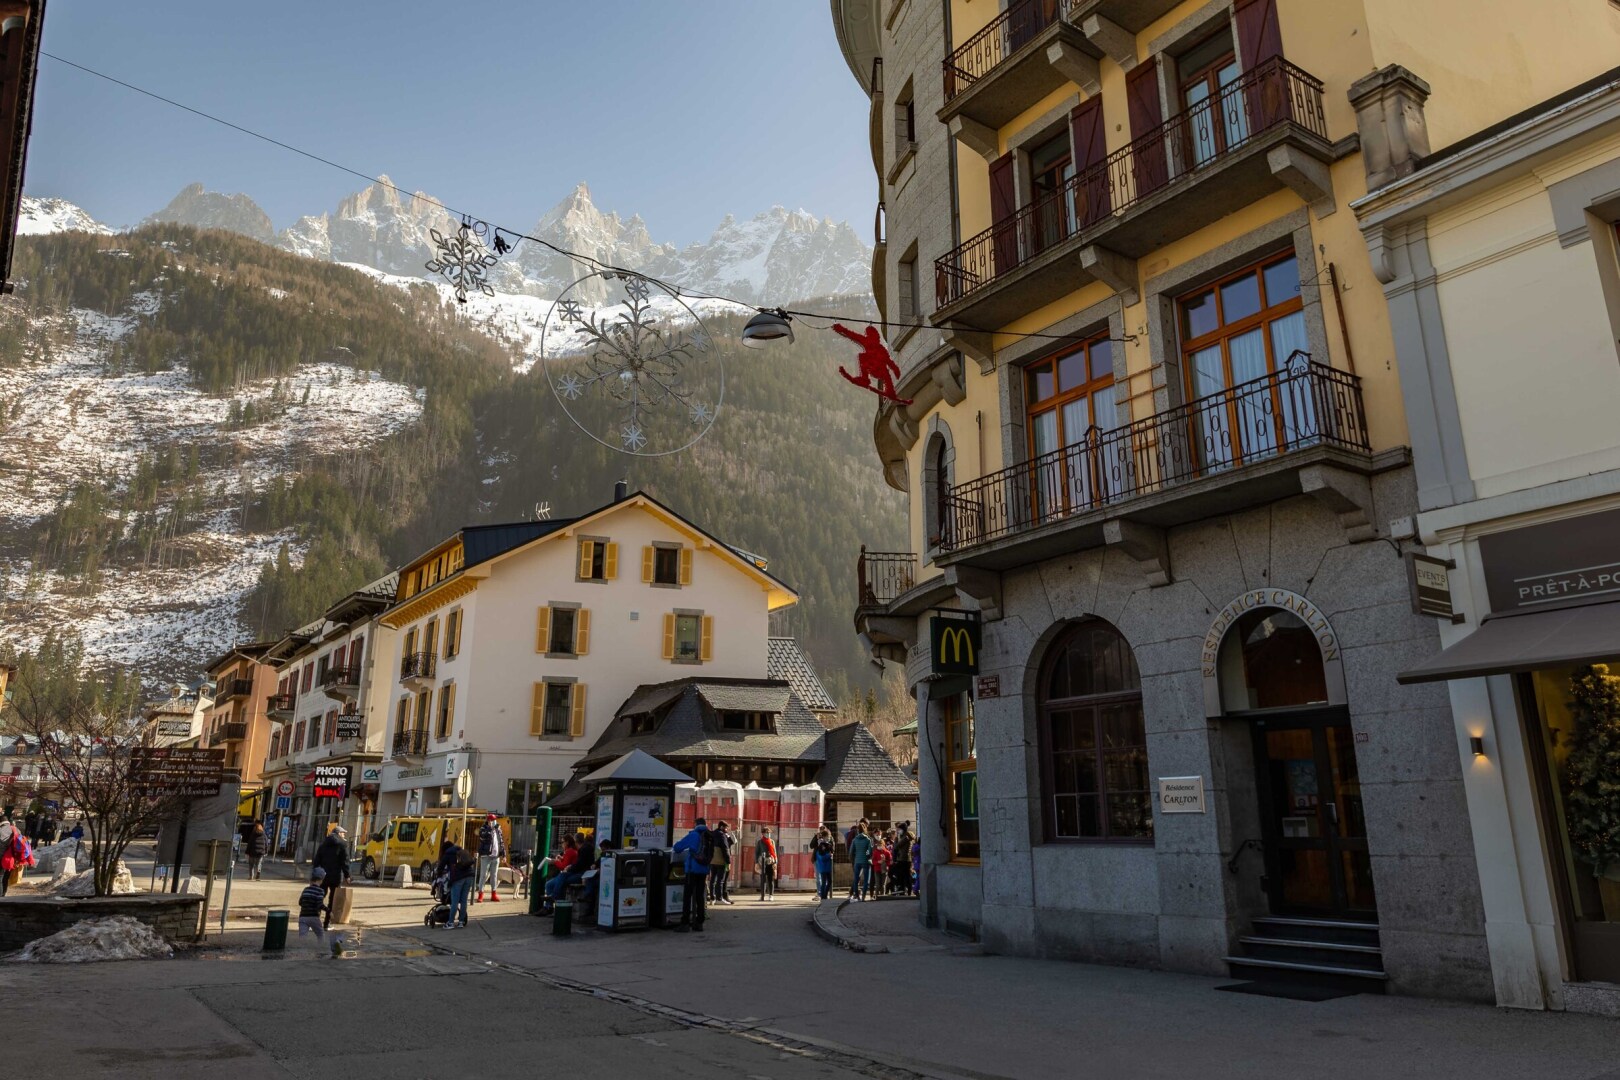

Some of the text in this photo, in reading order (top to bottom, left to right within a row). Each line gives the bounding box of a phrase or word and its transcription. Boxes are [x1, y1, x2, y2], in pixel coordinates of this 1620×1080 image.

[1418, 569, 1446, 582] EVENTS
[1203, 591, 1340, 678] RESIDENCE CARLTON
[170, 749, 189, 758] Gare
[316, 766, 348, 776] PHOTO
[314, 778, 346, 786] ALPINE
[1164, 794, 1198, 806] CARLTON
[636, 828, 664, 838] Guides
